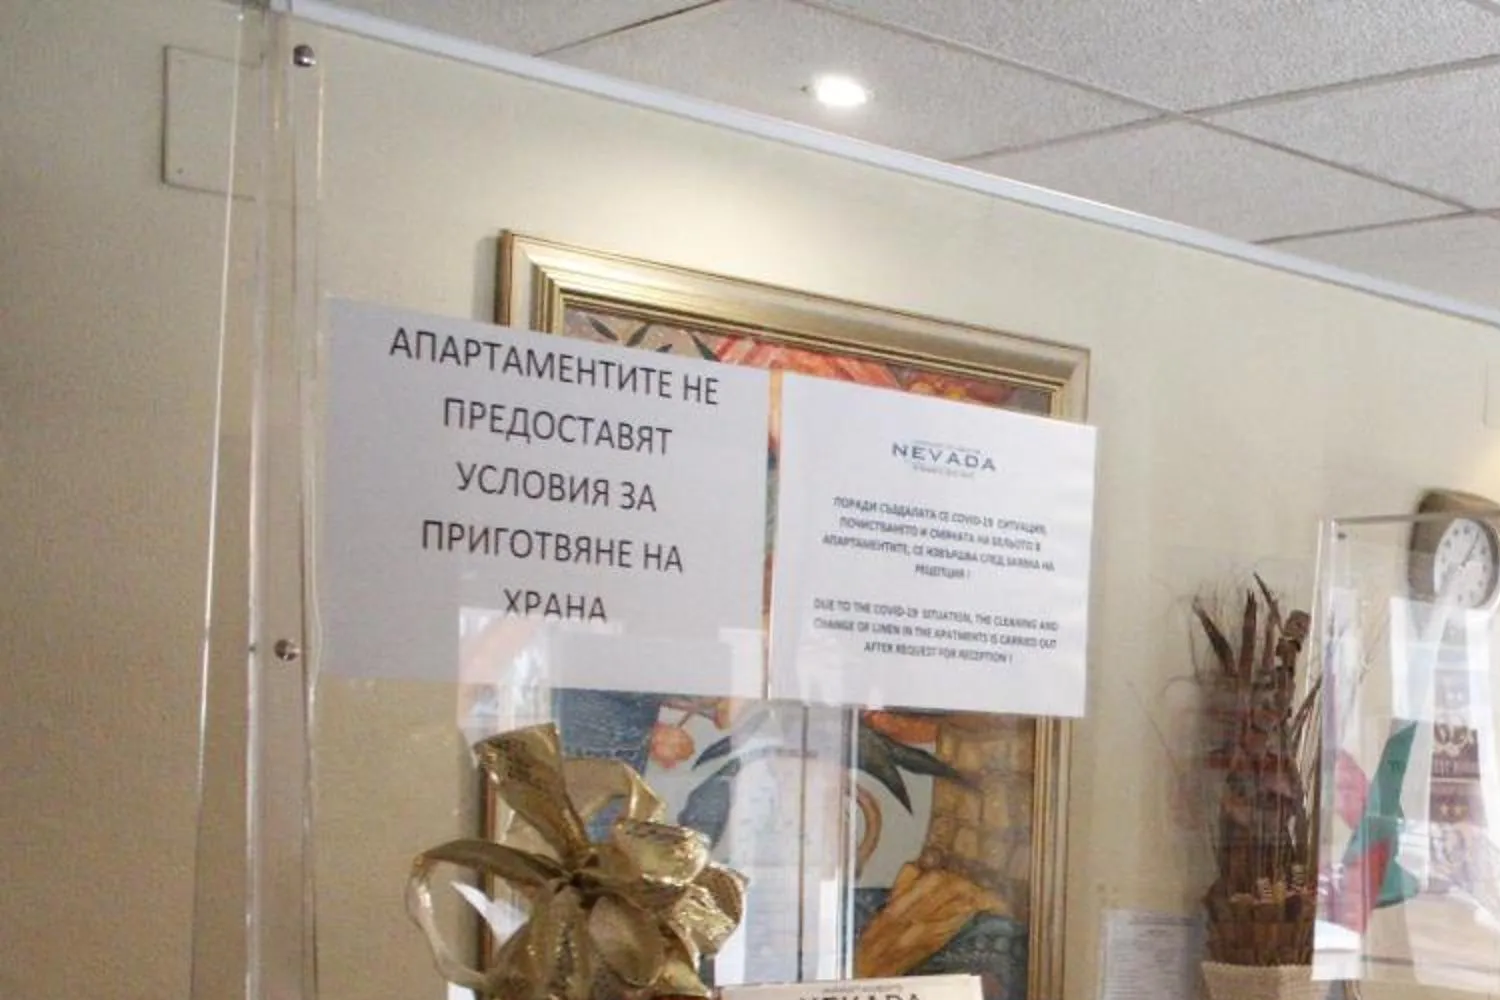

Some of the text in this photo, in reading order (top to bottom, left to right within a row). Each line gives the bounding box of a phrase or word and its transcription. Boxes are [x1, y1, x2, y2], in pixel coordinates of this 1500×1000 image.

[390, 327, 719, 405] АПАРТАМЕНТИТЕ НЕ
[445, 398, 672, 455] ПРЕДОСТАВЯТ
[892, 442, 996, 472] NEVADA
[457, 462, 656, 511] УСЛОВИЯ ЗА
[422, 521, 683, 574] ПРИГОТВЯНЕ НА
[504, 589, 607, 621] ХРАНА
